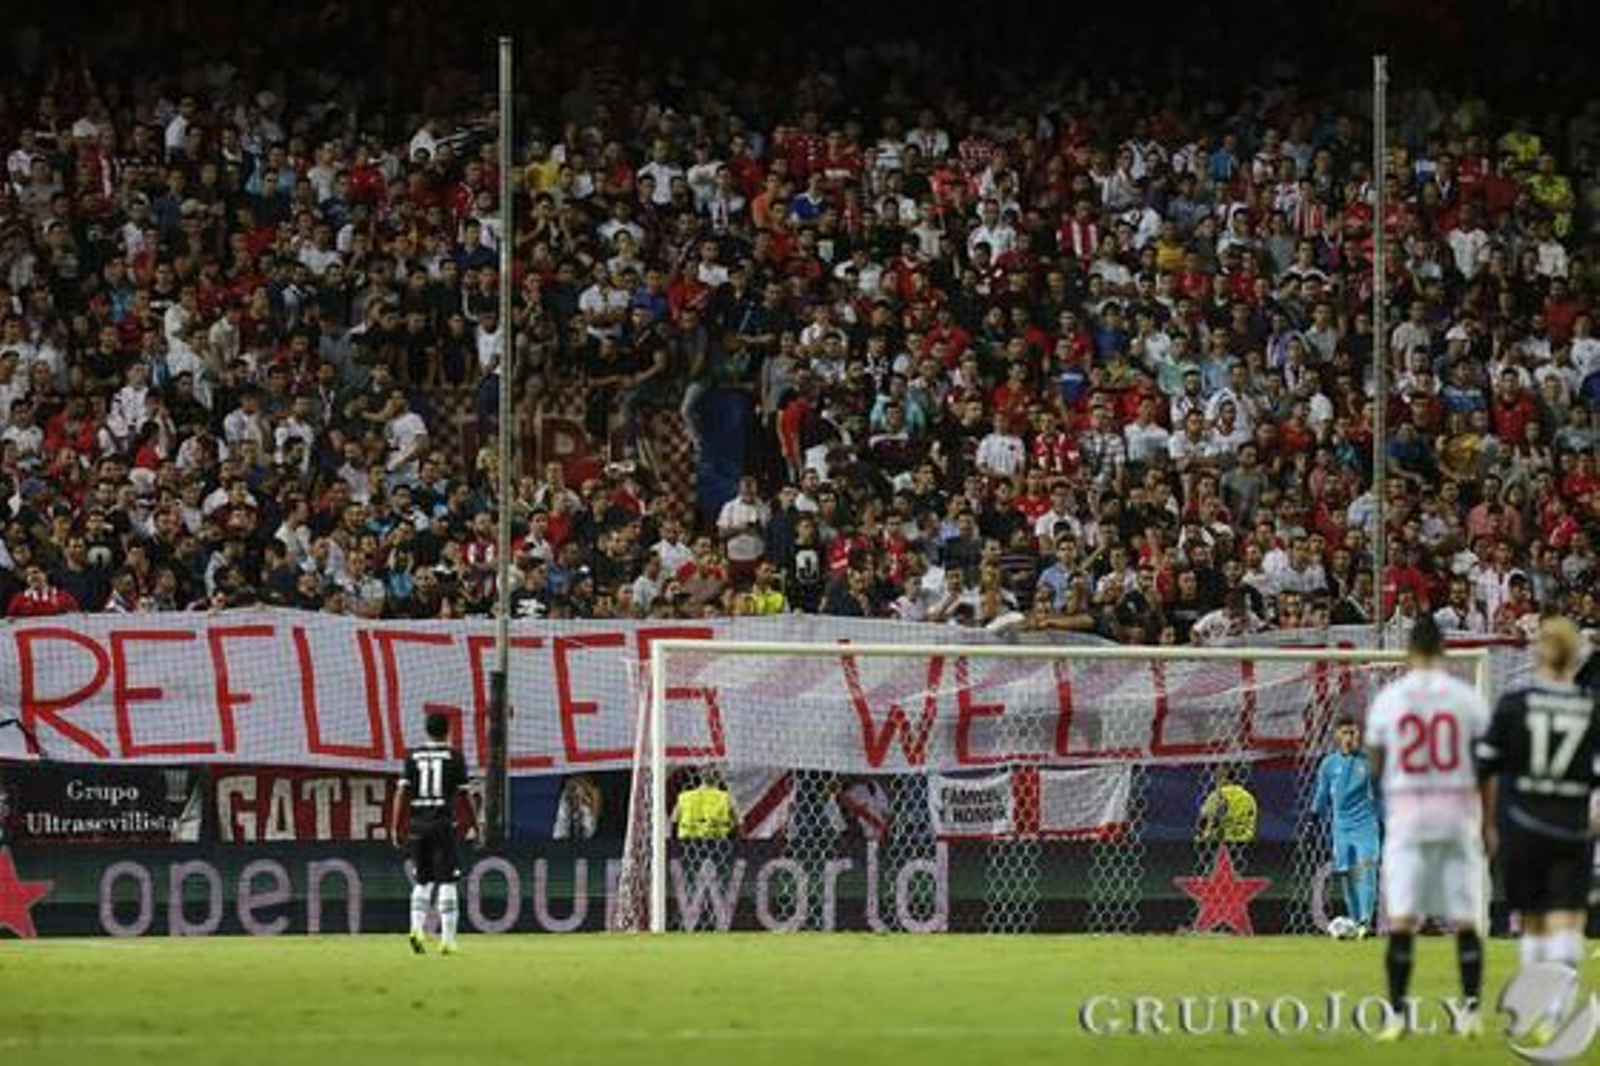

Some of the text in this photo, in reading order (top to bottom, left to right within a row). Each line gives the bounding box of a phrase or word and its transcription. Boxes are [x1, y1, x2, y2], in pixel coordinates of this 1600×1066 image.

[15, 625, 725, 769] REFUGEES
[1398, 712, 1461, 775] 20
[1525, 712, 1590, 778] 17
[66, 779, 139, 806] Grupo
[216, 776, 387, 841] GATE
[416, 759, 443, 798] 11
[25, 811, 180, 834] Ultrasevillista
[100, 857, 362, 936] open
[668, 840, 949, 934] world
